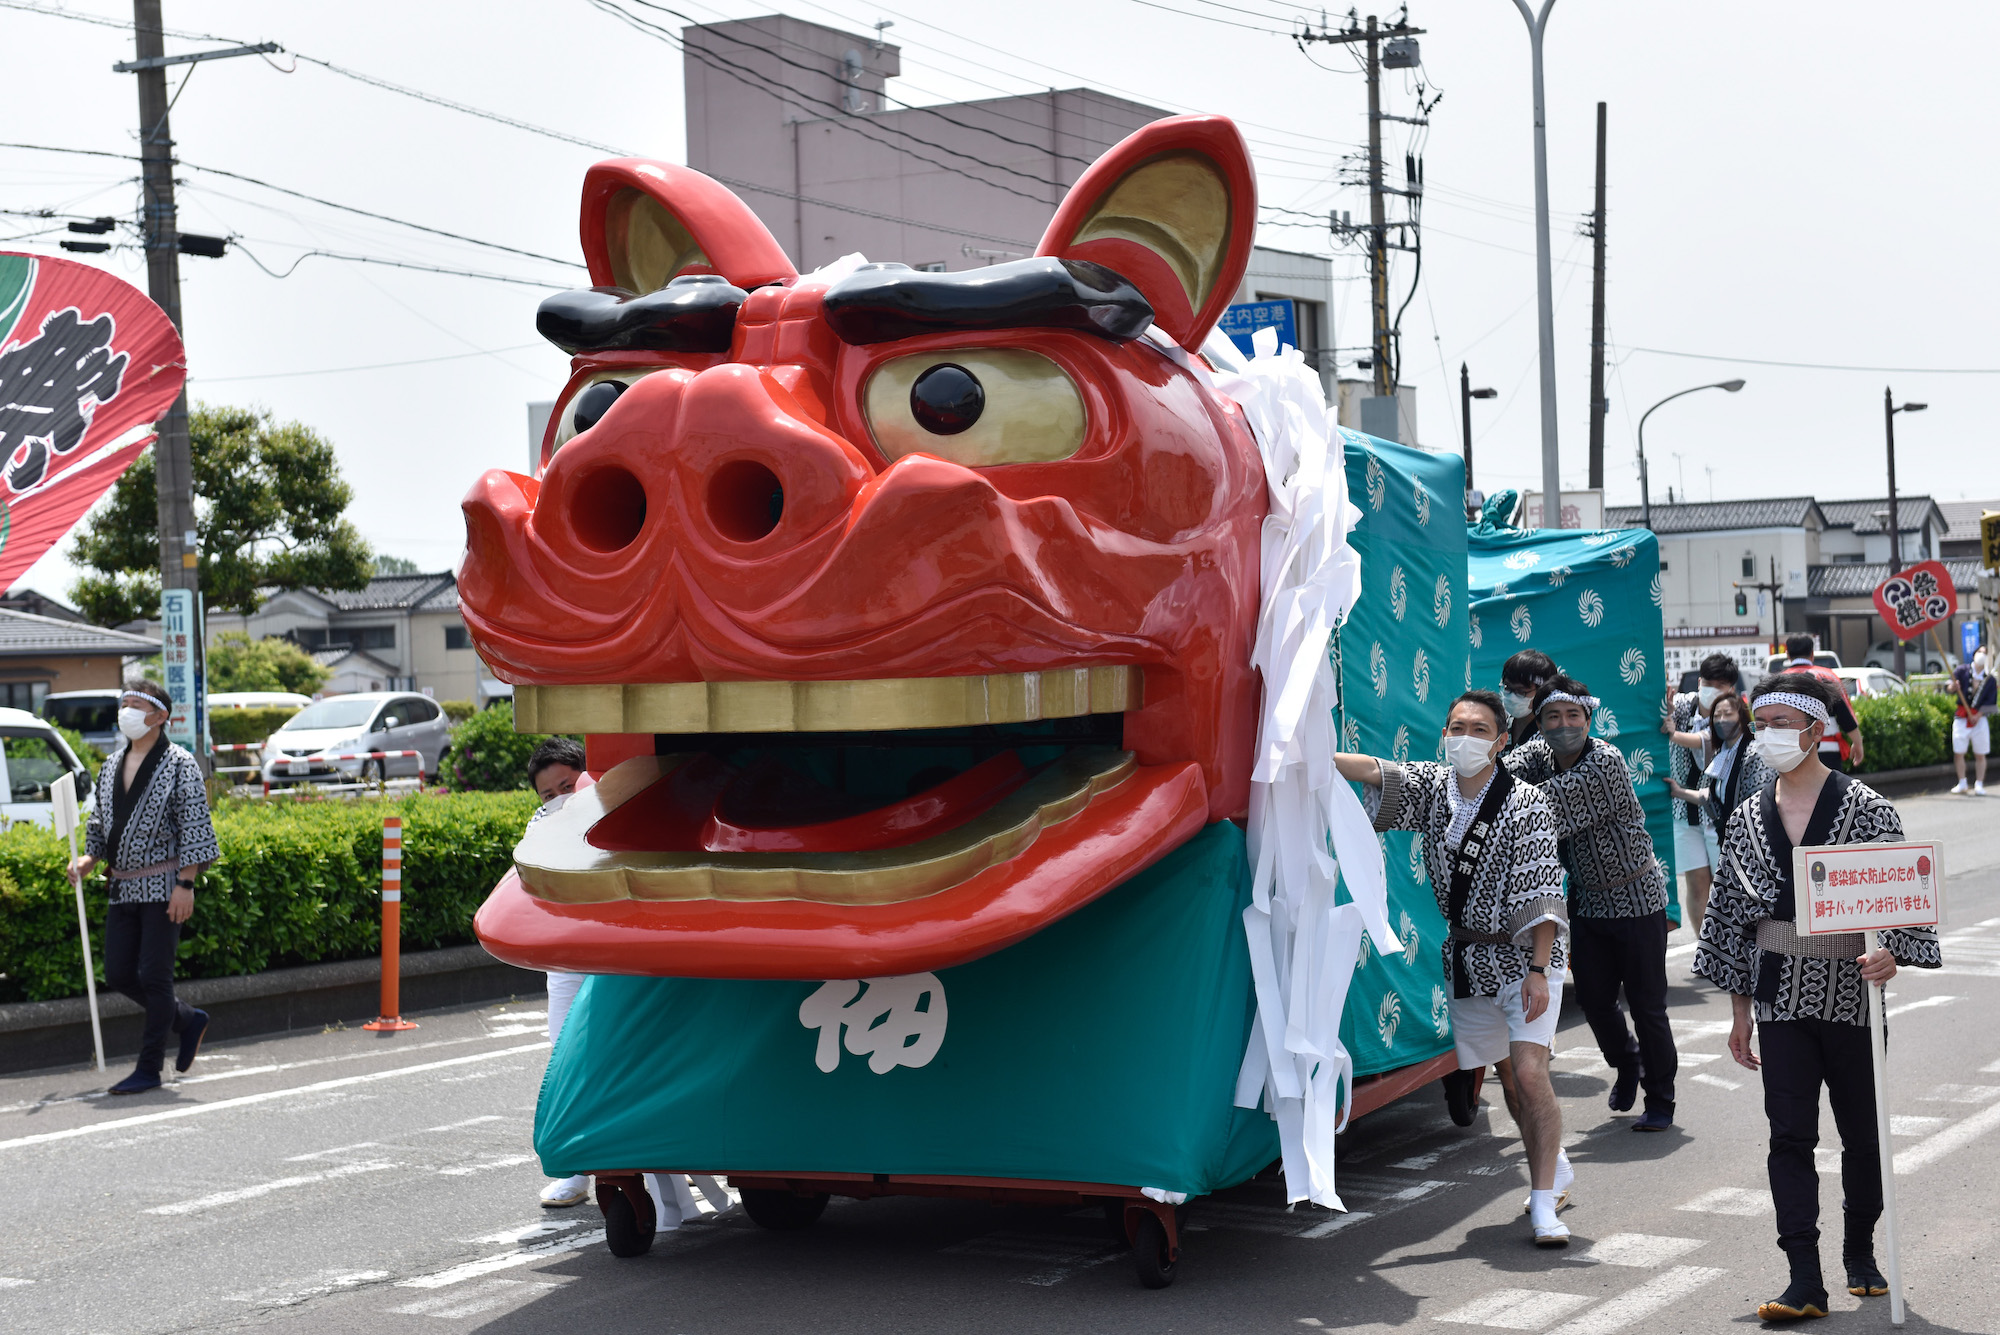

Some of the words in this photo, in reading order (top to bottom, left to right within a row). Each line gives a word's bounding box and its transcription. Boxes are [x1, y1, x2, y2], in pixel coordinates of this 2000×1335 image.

[1458, 821, 1490, 875] 酒田市
[1828, 865, 1916, 887] 感染拡大防止のため
[1814, 895, 1931, 918] 獅子パックンは行いません
